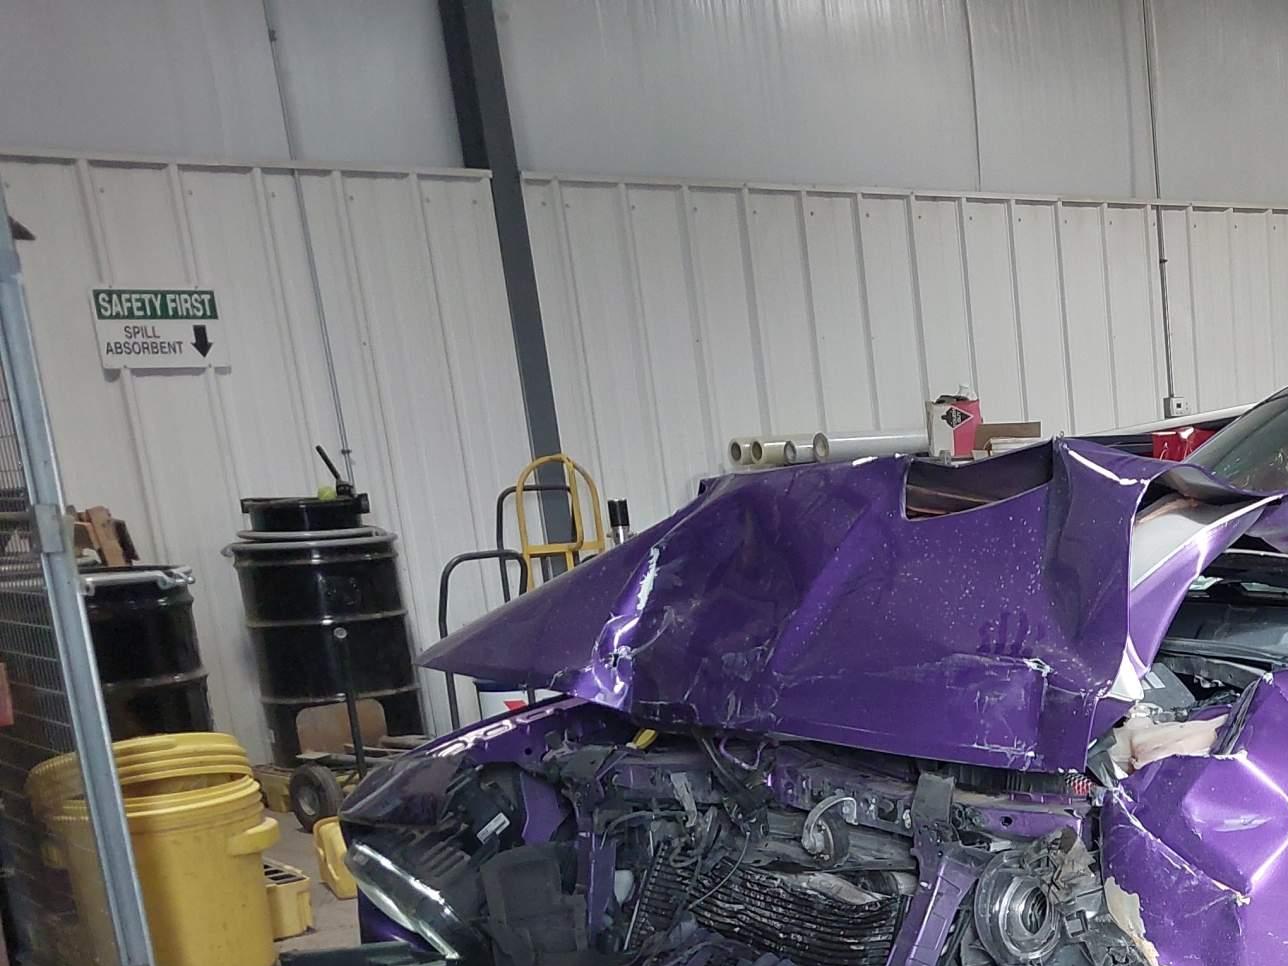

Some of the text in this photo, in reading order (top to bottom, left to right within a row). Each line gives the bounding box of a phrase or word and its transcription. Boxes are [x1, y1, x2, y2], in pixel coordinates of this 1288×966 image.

[99, 292, 212, 317] SAFETY FIRST
[123, 325, 161, 339] SPILL
[105, 341, 183, 355] ABSORBENT
